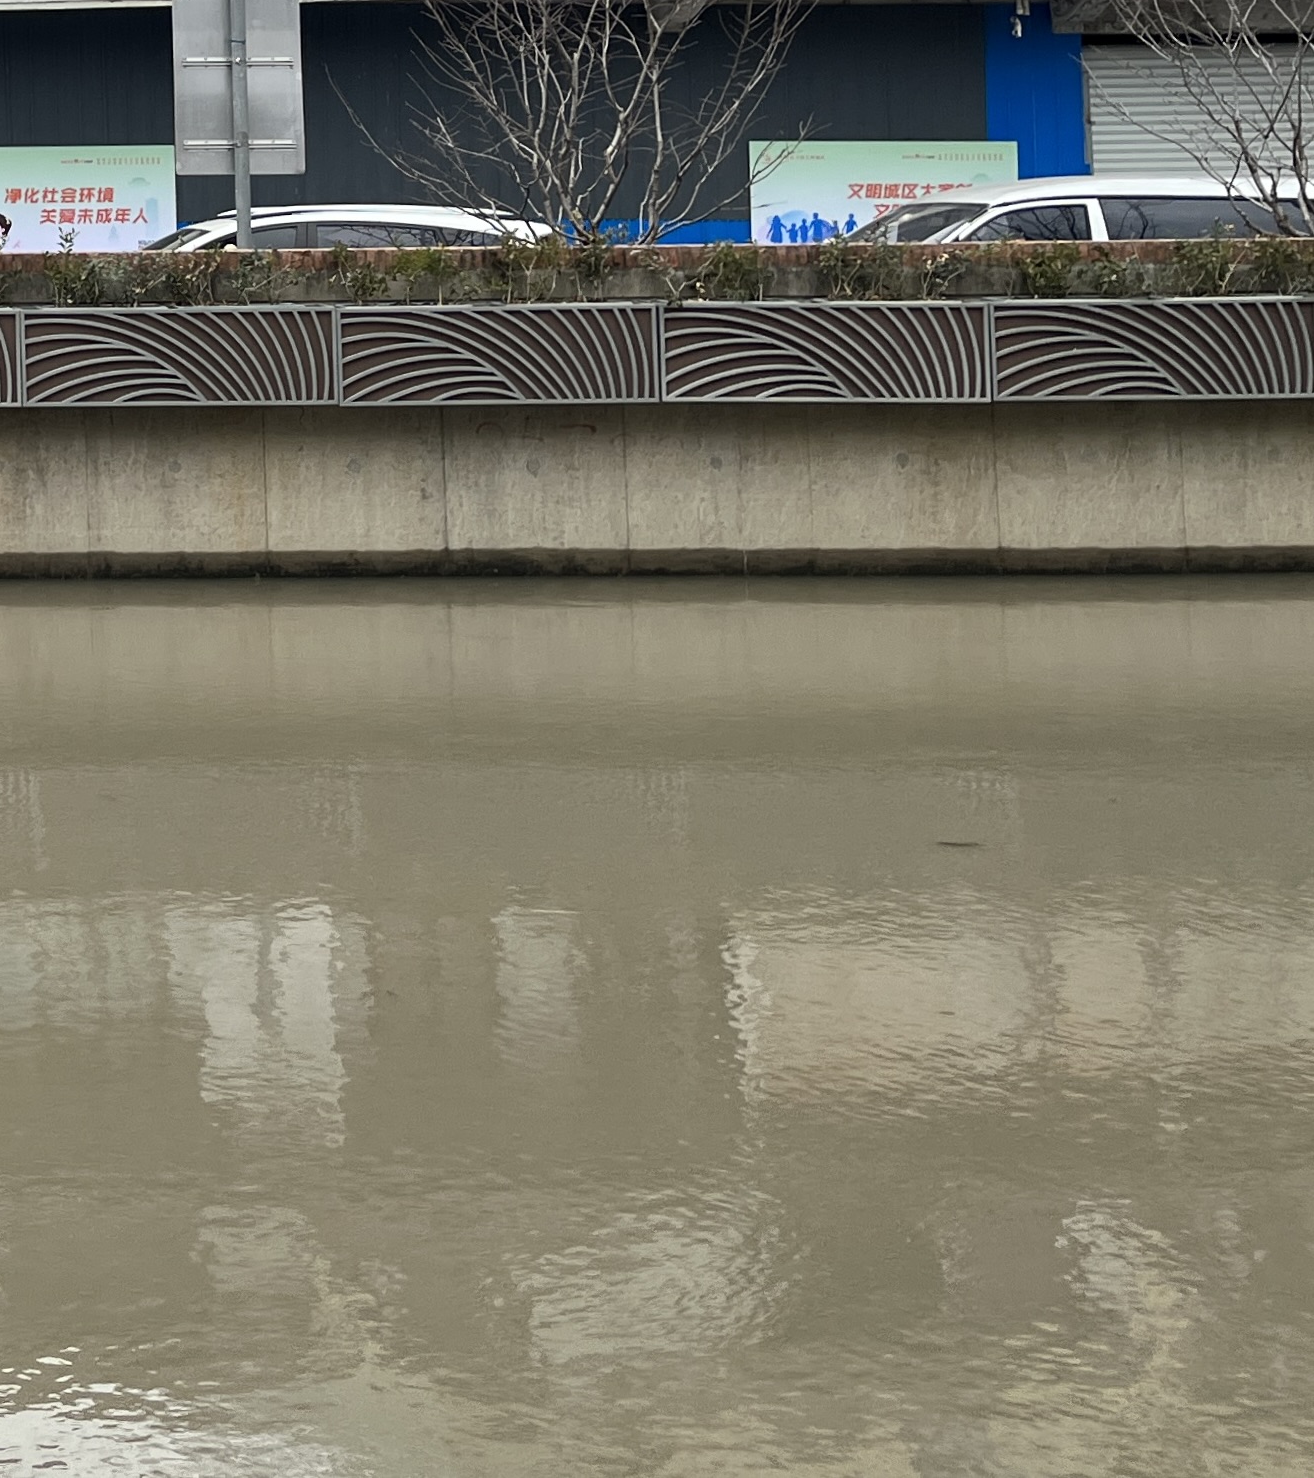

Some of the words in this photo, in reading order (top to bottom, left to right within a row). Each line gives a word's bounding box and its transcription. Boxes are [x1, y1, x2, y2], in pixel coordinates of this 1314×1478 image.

[4, 187, 114, 204] 净化社会环境
[39, 207, 149, 225] 关爱未成年人
